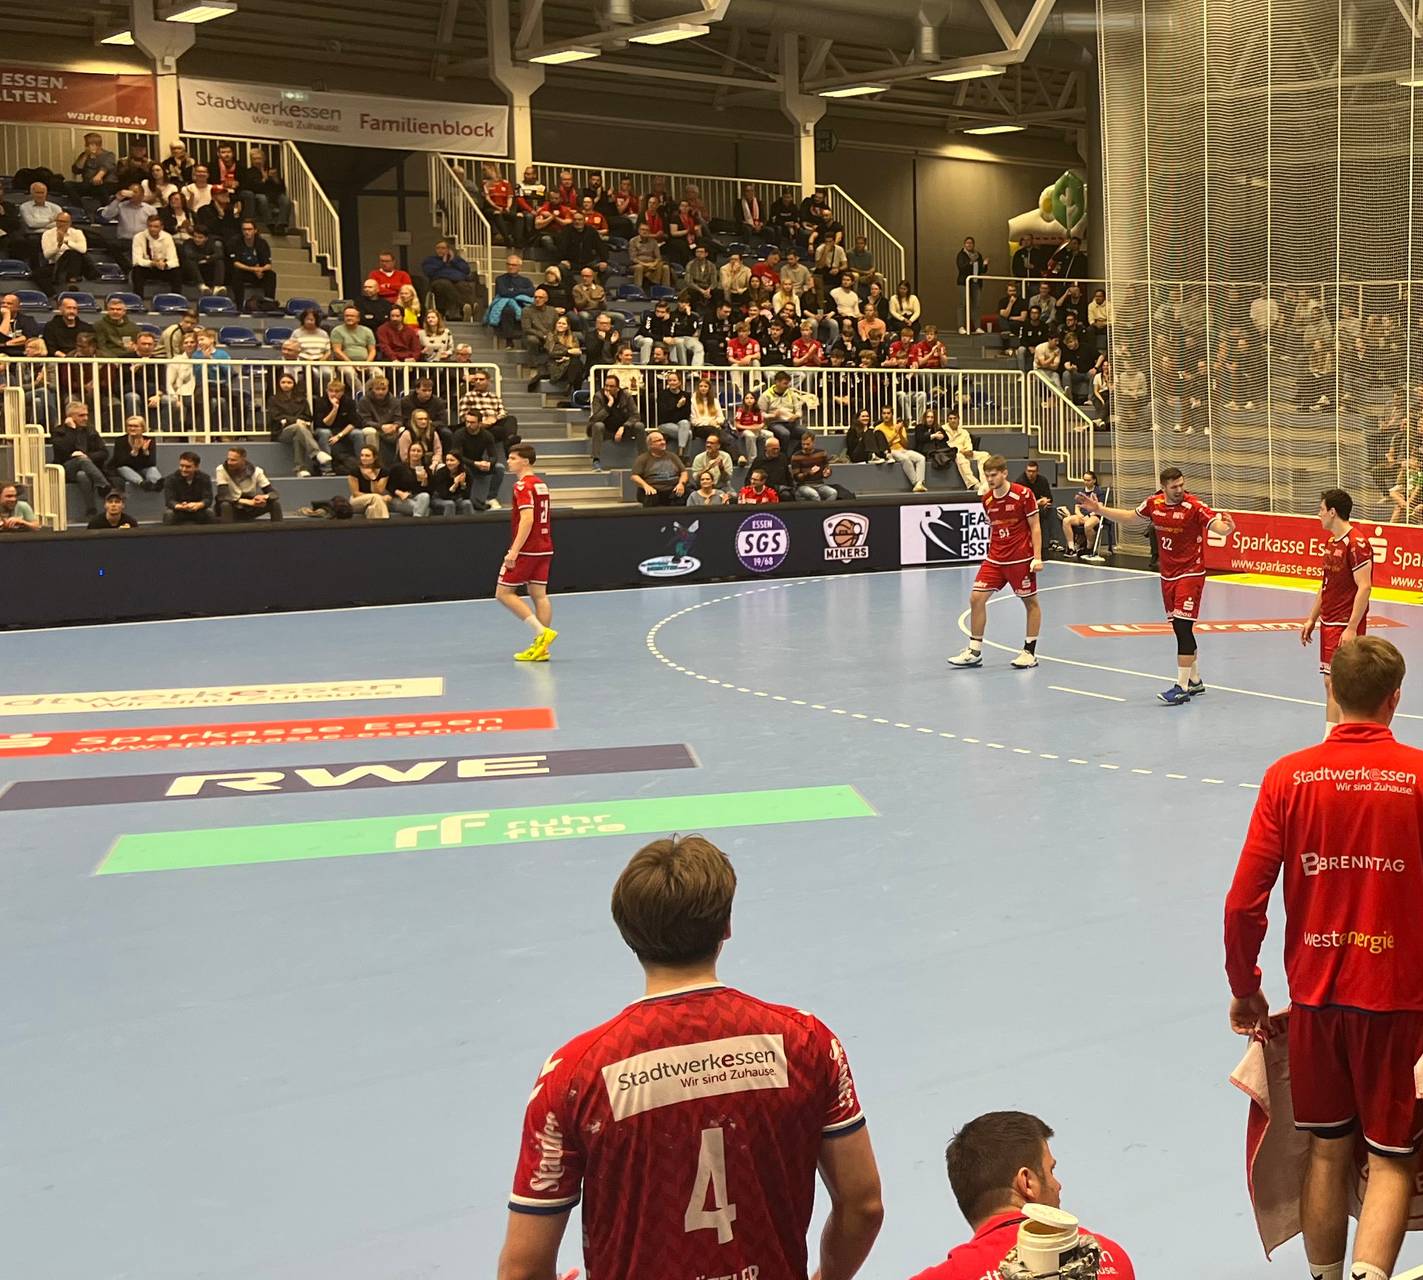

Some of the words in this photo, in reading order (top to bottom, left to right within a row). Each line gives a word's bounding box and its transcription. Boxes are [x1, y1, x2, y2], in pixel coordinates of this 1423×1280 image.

[1, 73, 68, 90] ESSEN.
[0, 89, 58, 104] LTEN.
[195, 90, 342, 121] Stadtwerkessen
[67, 111, 147, 125] wartezone.tv
[359, 113, 495, 138] Familienblock
[752, 519, 773, 530] ESSEN
[744, 531, 781, 555] SGS
[825, 548, 867, 560] MINERS
[1231, 530, 1305, 556] Sparkasse
[75, 725, 346, 746] Sparkasse
[364, 717, 504, 731] Essen
[164, 755, 551, 797] RWE
[1292, 766, 1417, 786] Stadtwerkessen
[1336, 782, 1351, 792] Wir
[1353, 782, 1372, 792] sind
[503, 822, 627, 840] fibre
[1318, 855, 1405, 873] BRENNTAG
[1303, 930, 1395, 954] westenergie
[617, 1047, 777, 1092] Stadtwerkessen
[680, 1075, 699, 1090] Wir
[702, 1071, 728, 1086] sind
[730, 1066, 777, 1082] Zuhause.
[684, 1127, 737, 1245] 4
